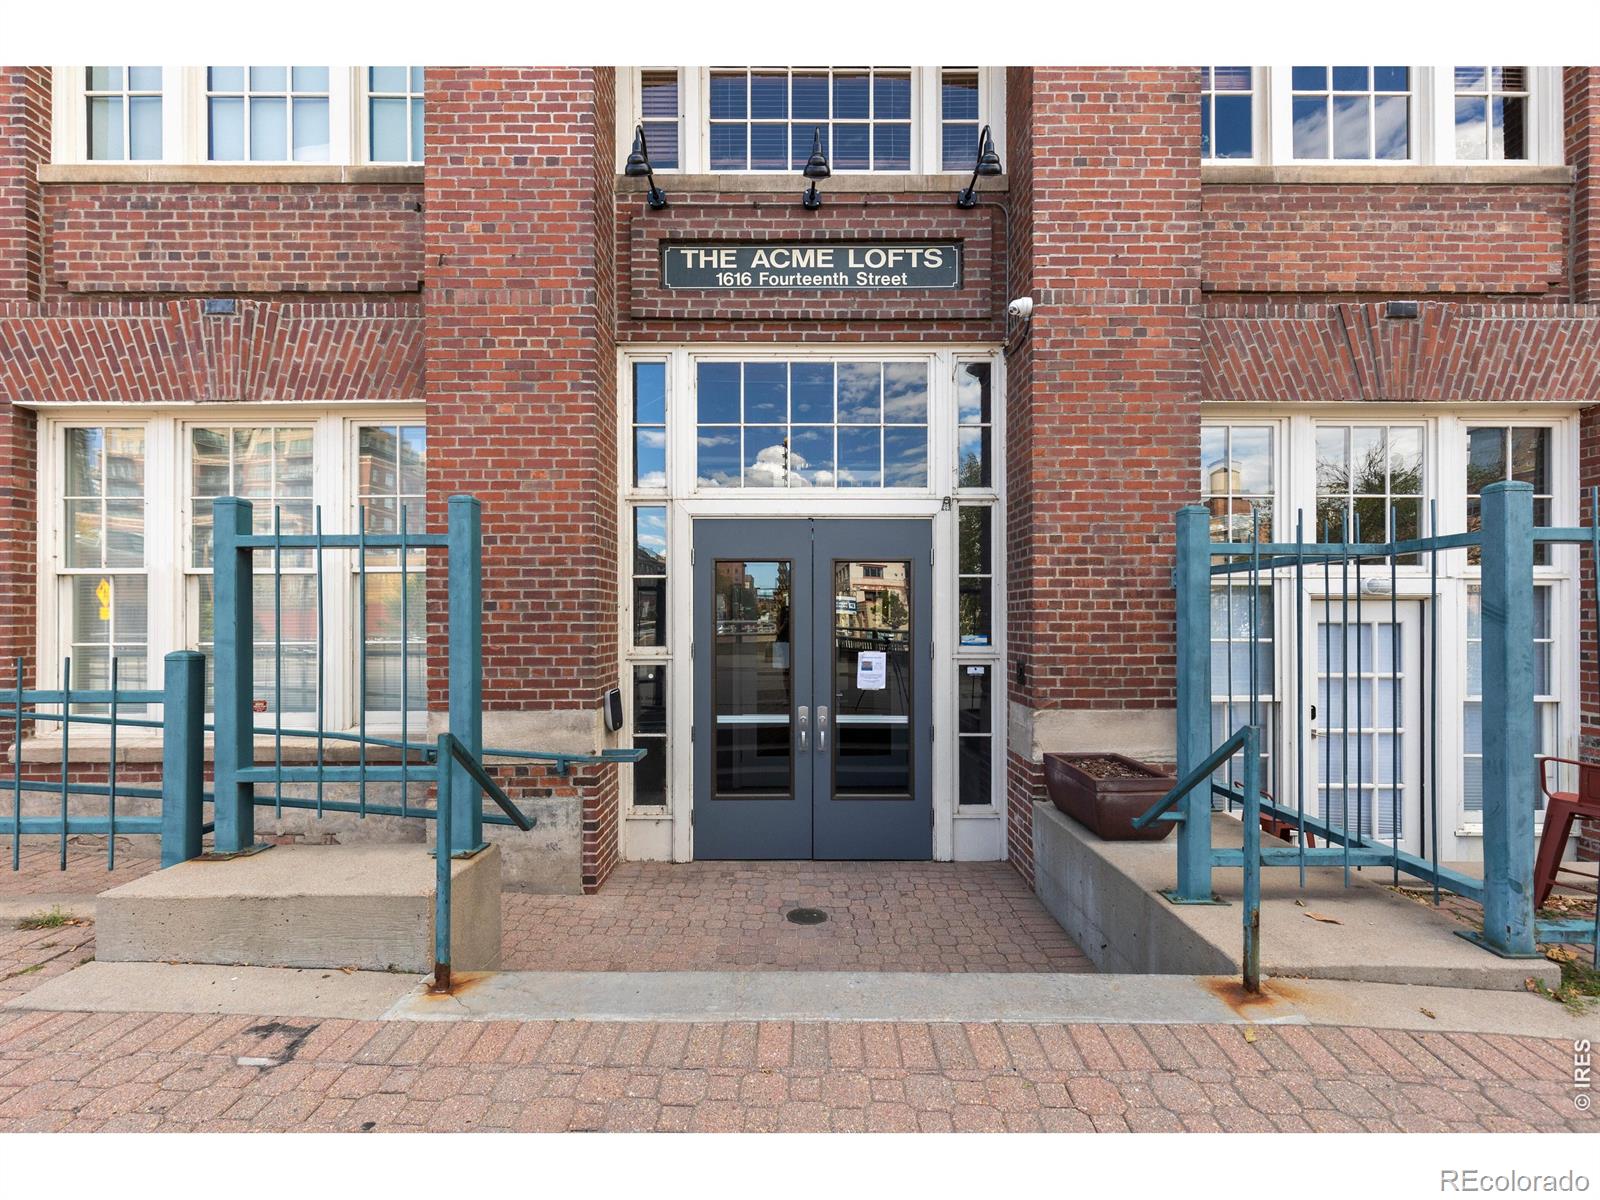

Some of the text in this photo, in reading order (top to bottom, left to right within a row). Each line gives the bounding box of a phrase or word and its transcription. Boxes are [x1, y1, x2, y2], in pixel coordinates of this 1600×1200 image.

[680, 247, 944, 269] THE ACME LOFTS
[715, 271, 908, 287] 1616 Fourteenth Street
